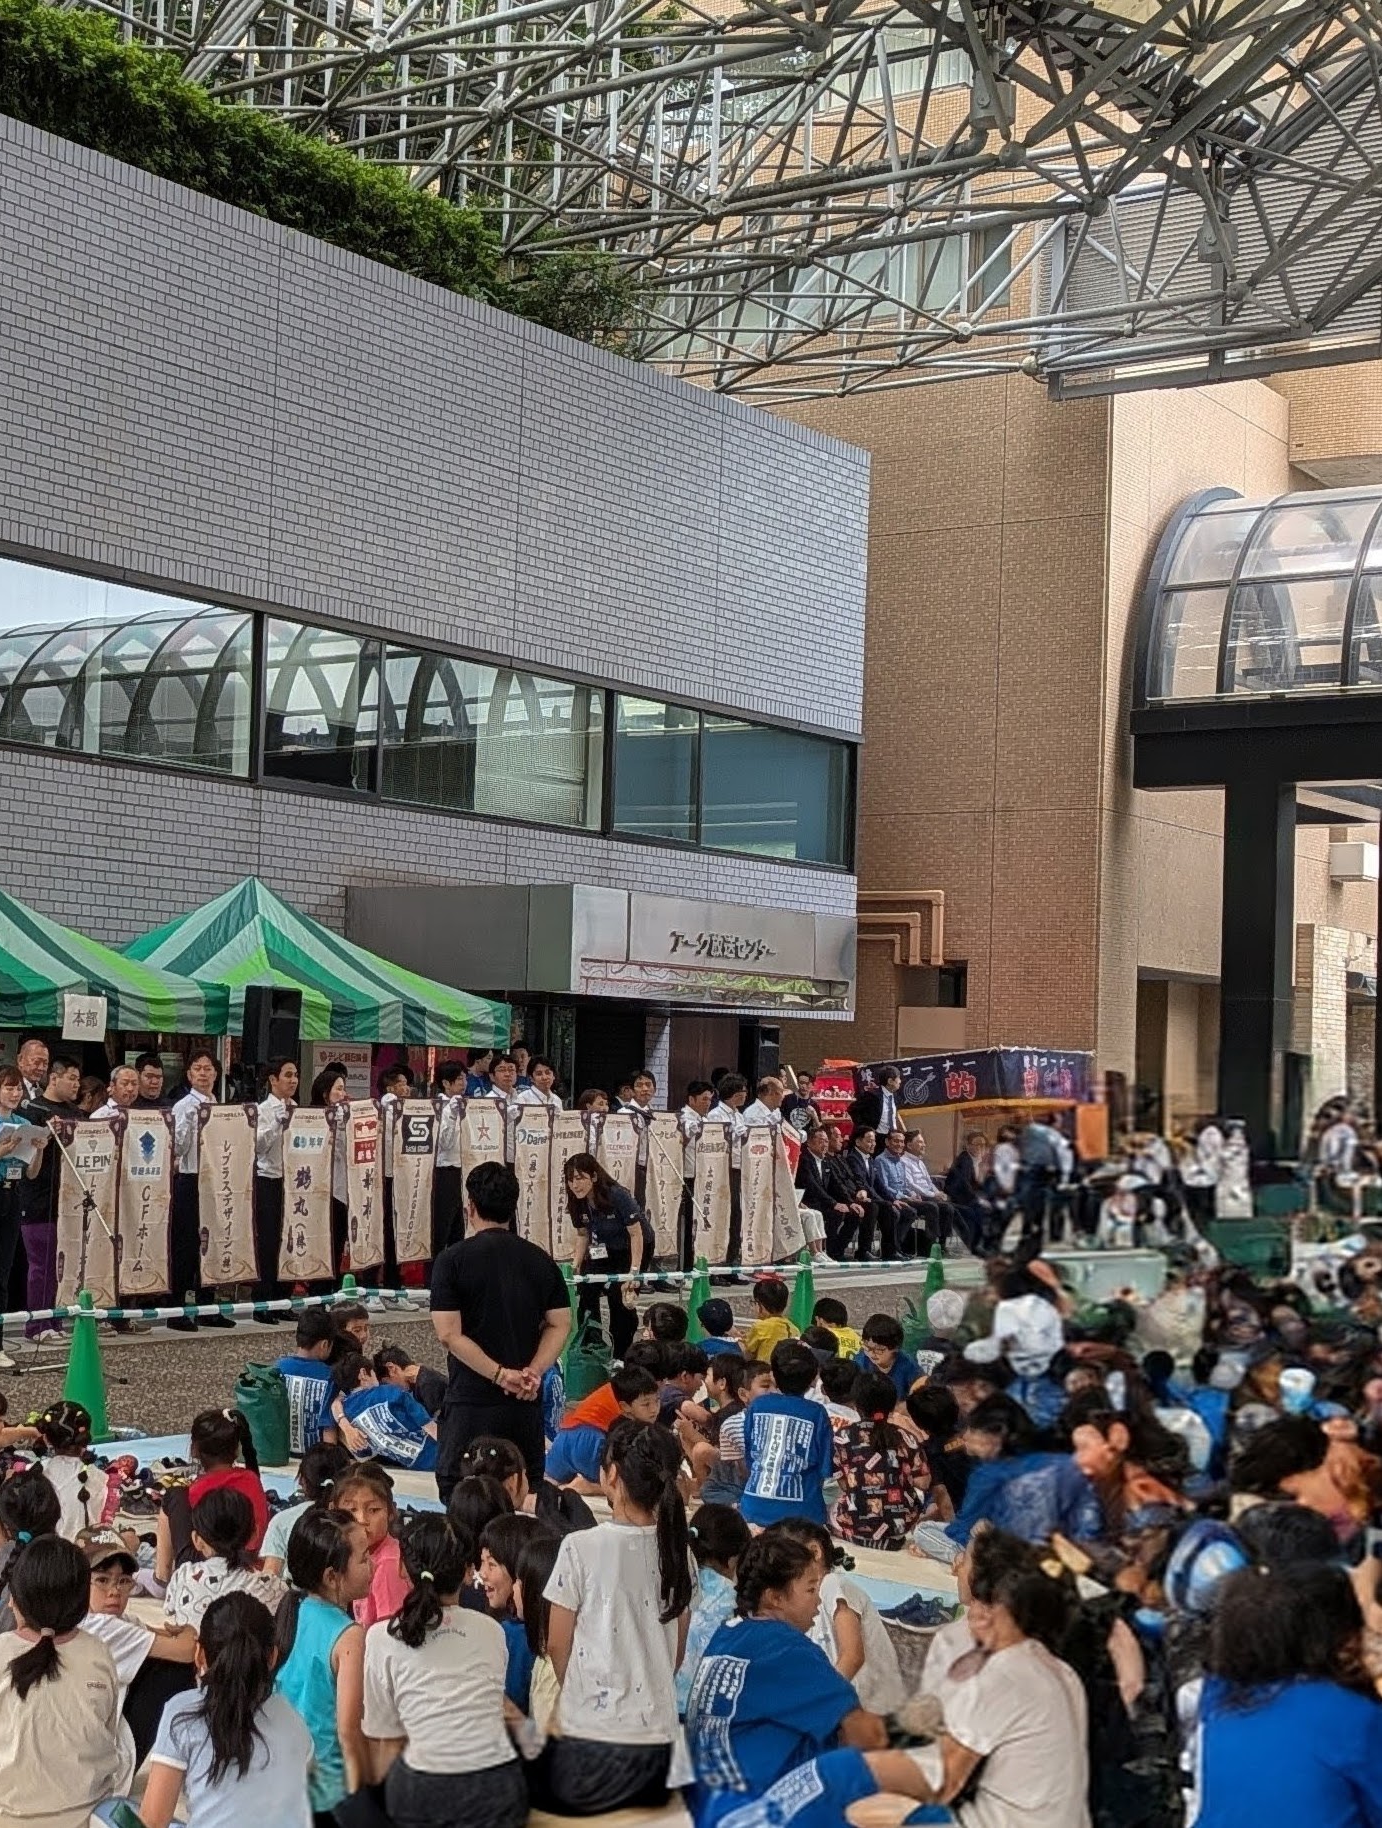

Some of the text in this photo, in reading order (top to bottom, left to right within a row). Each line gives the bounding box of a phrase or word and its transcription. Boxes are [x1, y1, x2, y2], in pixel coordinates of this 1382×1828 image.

[73, 1009, 98, 1028] 本部
[133, 1185, 151, 1272] CFホーム
